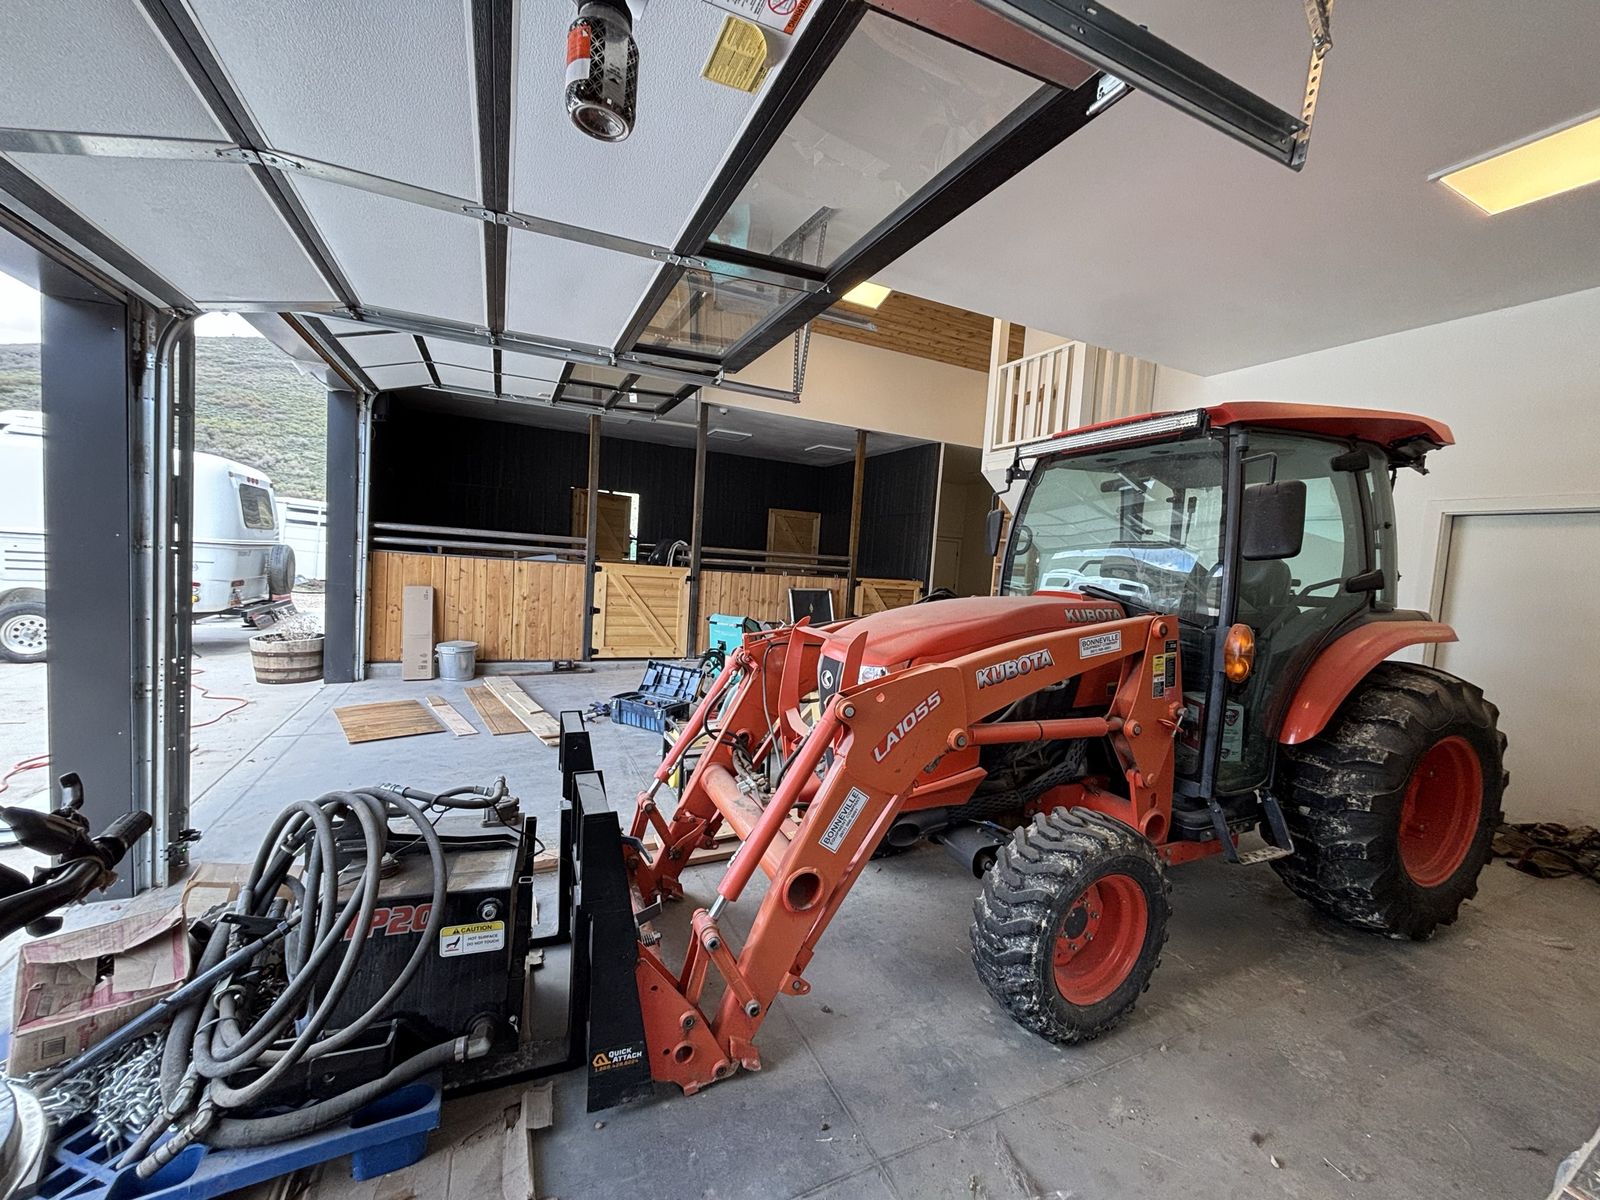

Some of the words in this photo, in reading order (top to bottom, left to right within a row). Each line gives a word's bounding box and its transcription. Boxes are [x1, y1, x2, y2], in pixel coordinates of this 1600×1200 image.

[1064, 608, 1122, 622] KUBOTA
[1081, 634, 1118, 648] BONNEVILLE
[976, 649, 1054, 689] KUBOTA
[872, 690, 942, 763] LA1055
[823, 791, 859, 845] BONNEVILLE
[460, 924, 493, 934] CAUTION
[478, 933, 498, 941] SURFACE
[608, 1046, 633, 1058] QUICK
[612, 1051, 643, 1063] ATTACH
